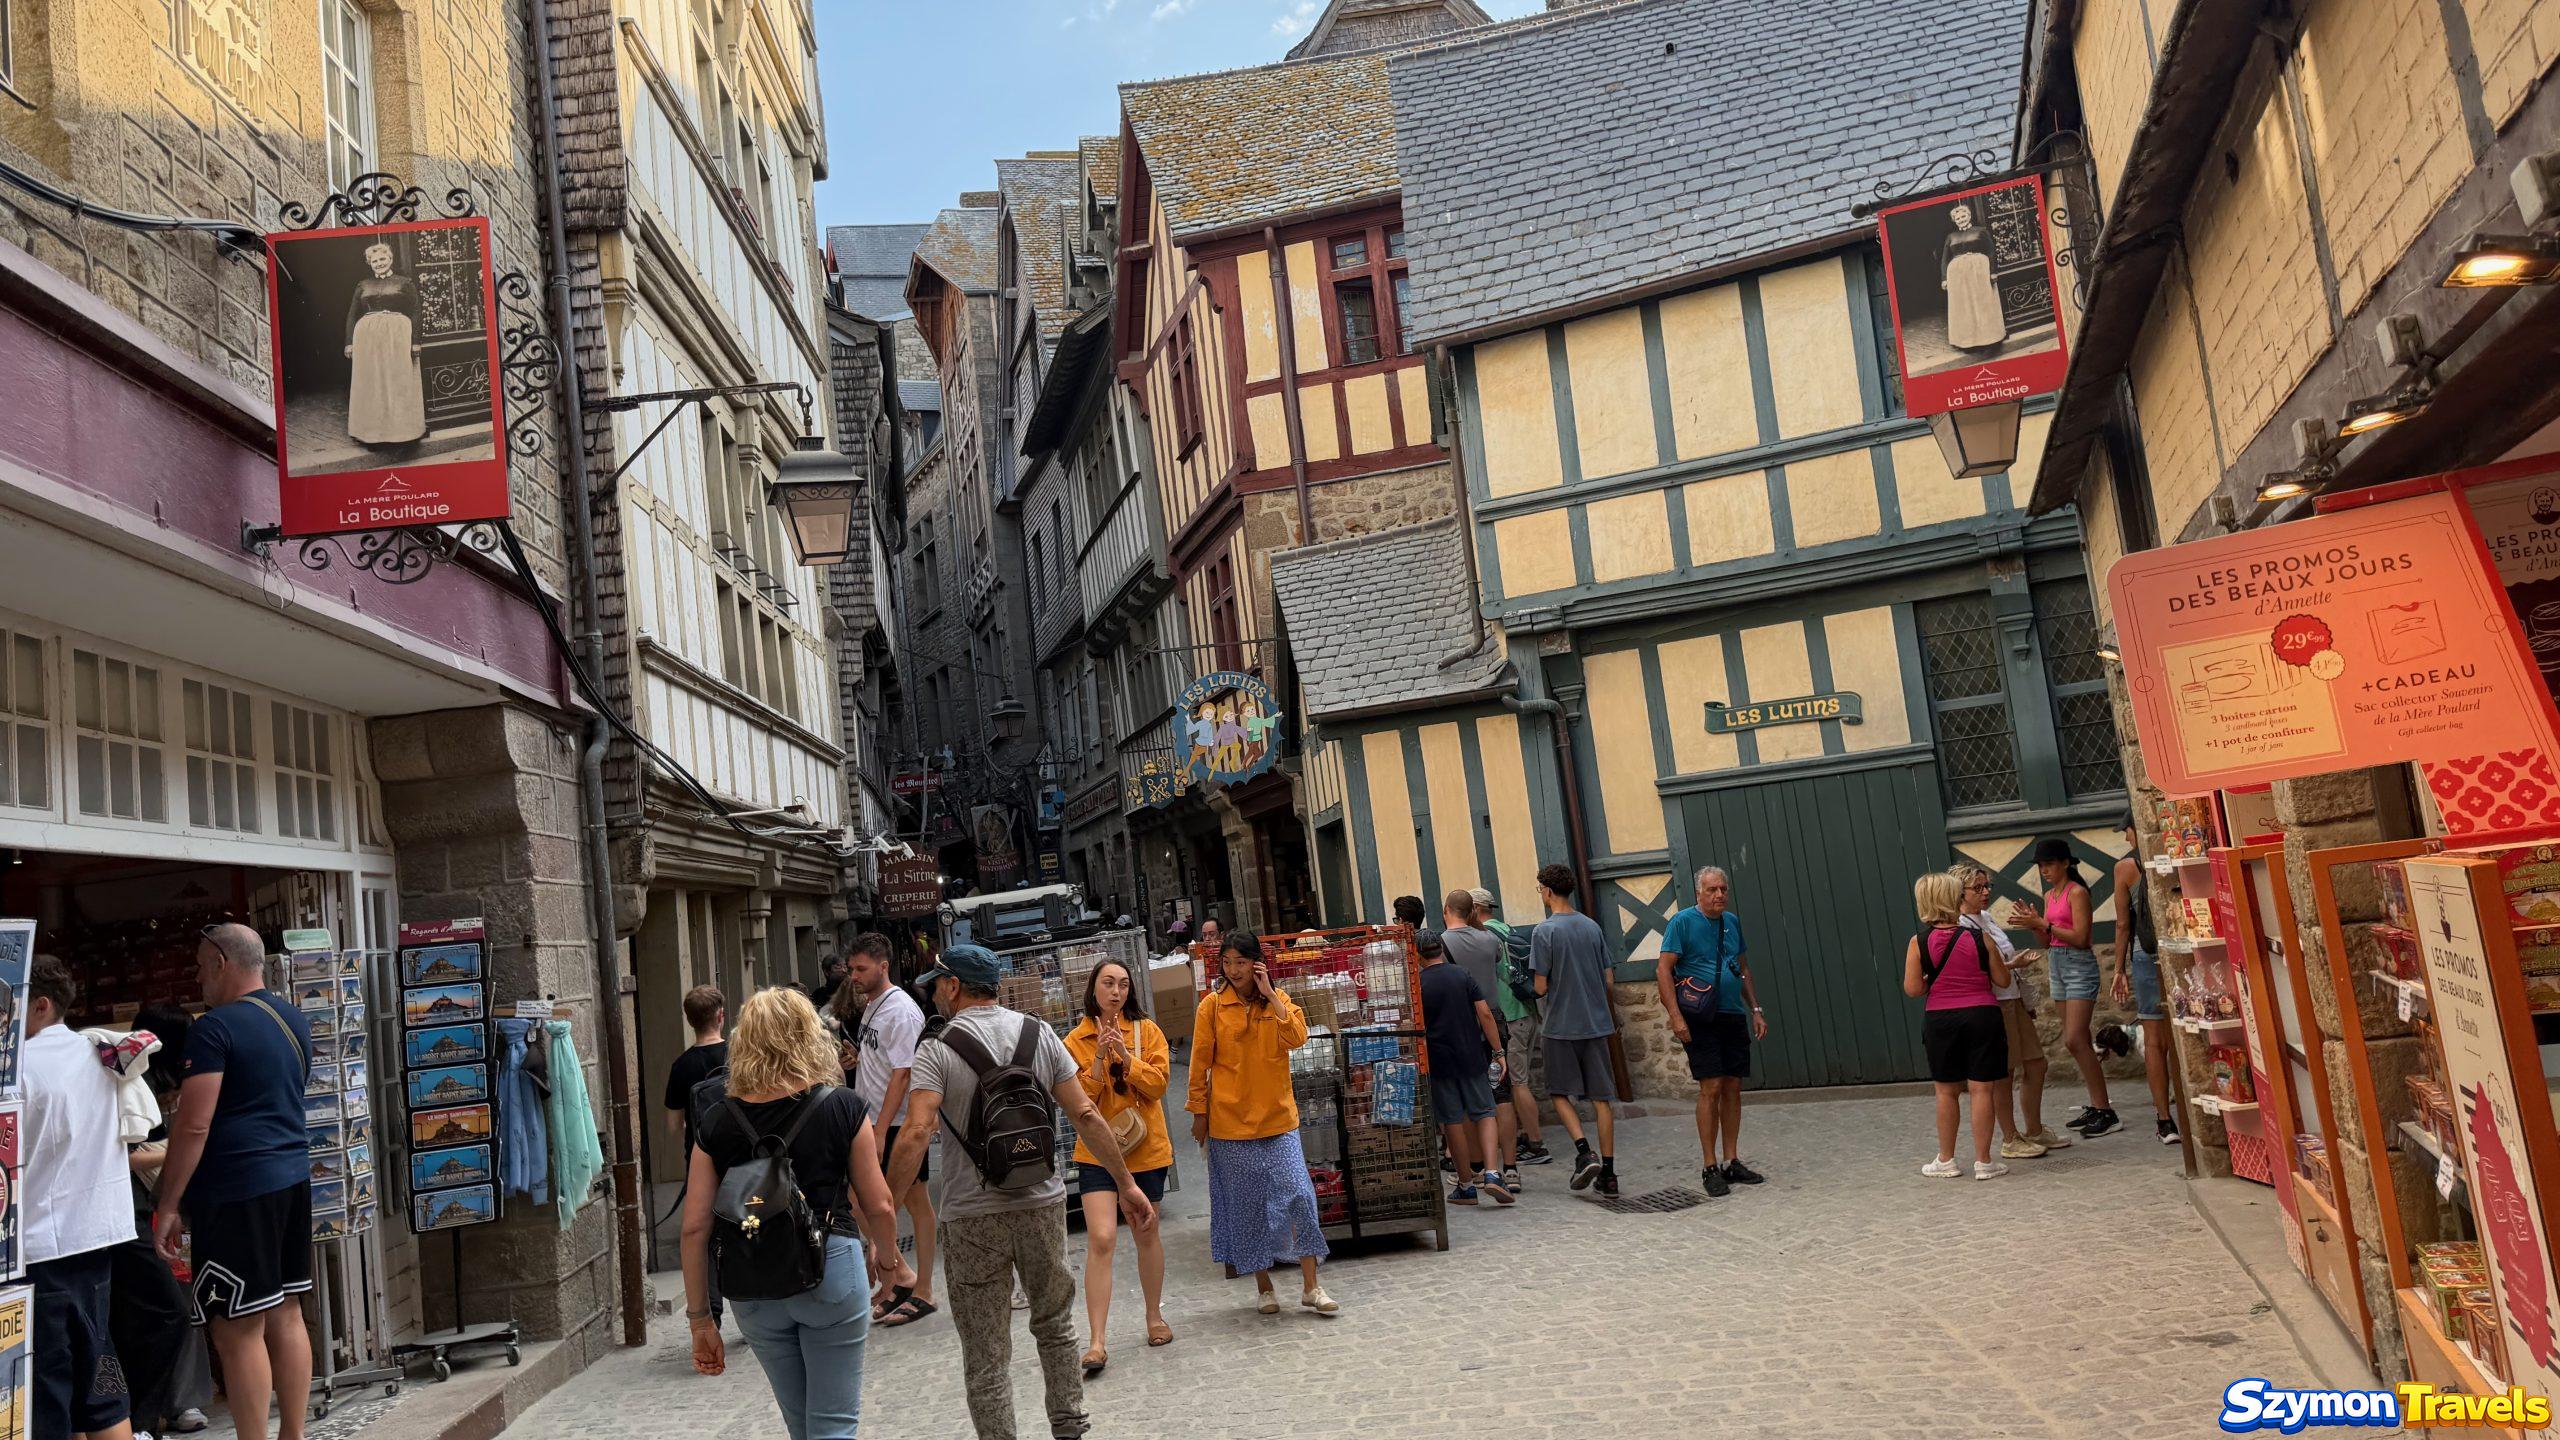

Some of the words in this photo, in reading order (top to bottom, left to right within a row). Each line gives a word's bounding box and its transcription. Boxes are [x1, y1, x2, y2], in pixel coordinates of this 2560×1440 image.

[1986, 376, 2021, 387] POULARD
[1947, 396, 1963, 407] La
[1969, 384, 2030, 403] Boutique
[393, 492, 440, 501] POULARD
[339, 510, 360, 524] La
[369, 504, 450, 521] Boutique
[2196, 568, 2240, 590] LES
[2249, 544, 2360, 579] PROMOS
[2168, 590, 2217, 613] DES
[2228, 571, 2314, 602] BEAUX
[2325, 553, 2413, 584] JOURS
[2254, 590, 2333, 616] d'Annette
[1179, 684, 1205, 711] LES
[2354, 702, 2377, 714] Sac
[2381, 693, 2439, 710] collector
[2441, 683, 2494, 699] Souvenirs
[1725, 708, 1762, 727] LES
[2210, 715, 2218, 725] 3
[2220, 710, 2256, 723] boîtes
[2259, 703, 2298, 717] carton
[2373, 714, 2386, 726] de
[2389, 713, 2400, 724] la
[2403, 708, 2433, 721] Mère
[2437, 699, 2481, 716] Poulard
[2222, 737, 2242, 749] pot
[2244, 733, 2259, 743] de
[2261, 726, 2316, 741] confiture
[2398, 727, 2414, 738] Gift
[2416, 723, 2447, 735] collector
[2449, 721, 2463, 731] bag
[883, 853, 936, 867] MAGSIN
[884, 872, 899, 885] La
[903, 867, 936, 884] Sirène
[2431, 946, 2445, 969] LES
[2444, 950, 2478, 980] PROMOS
